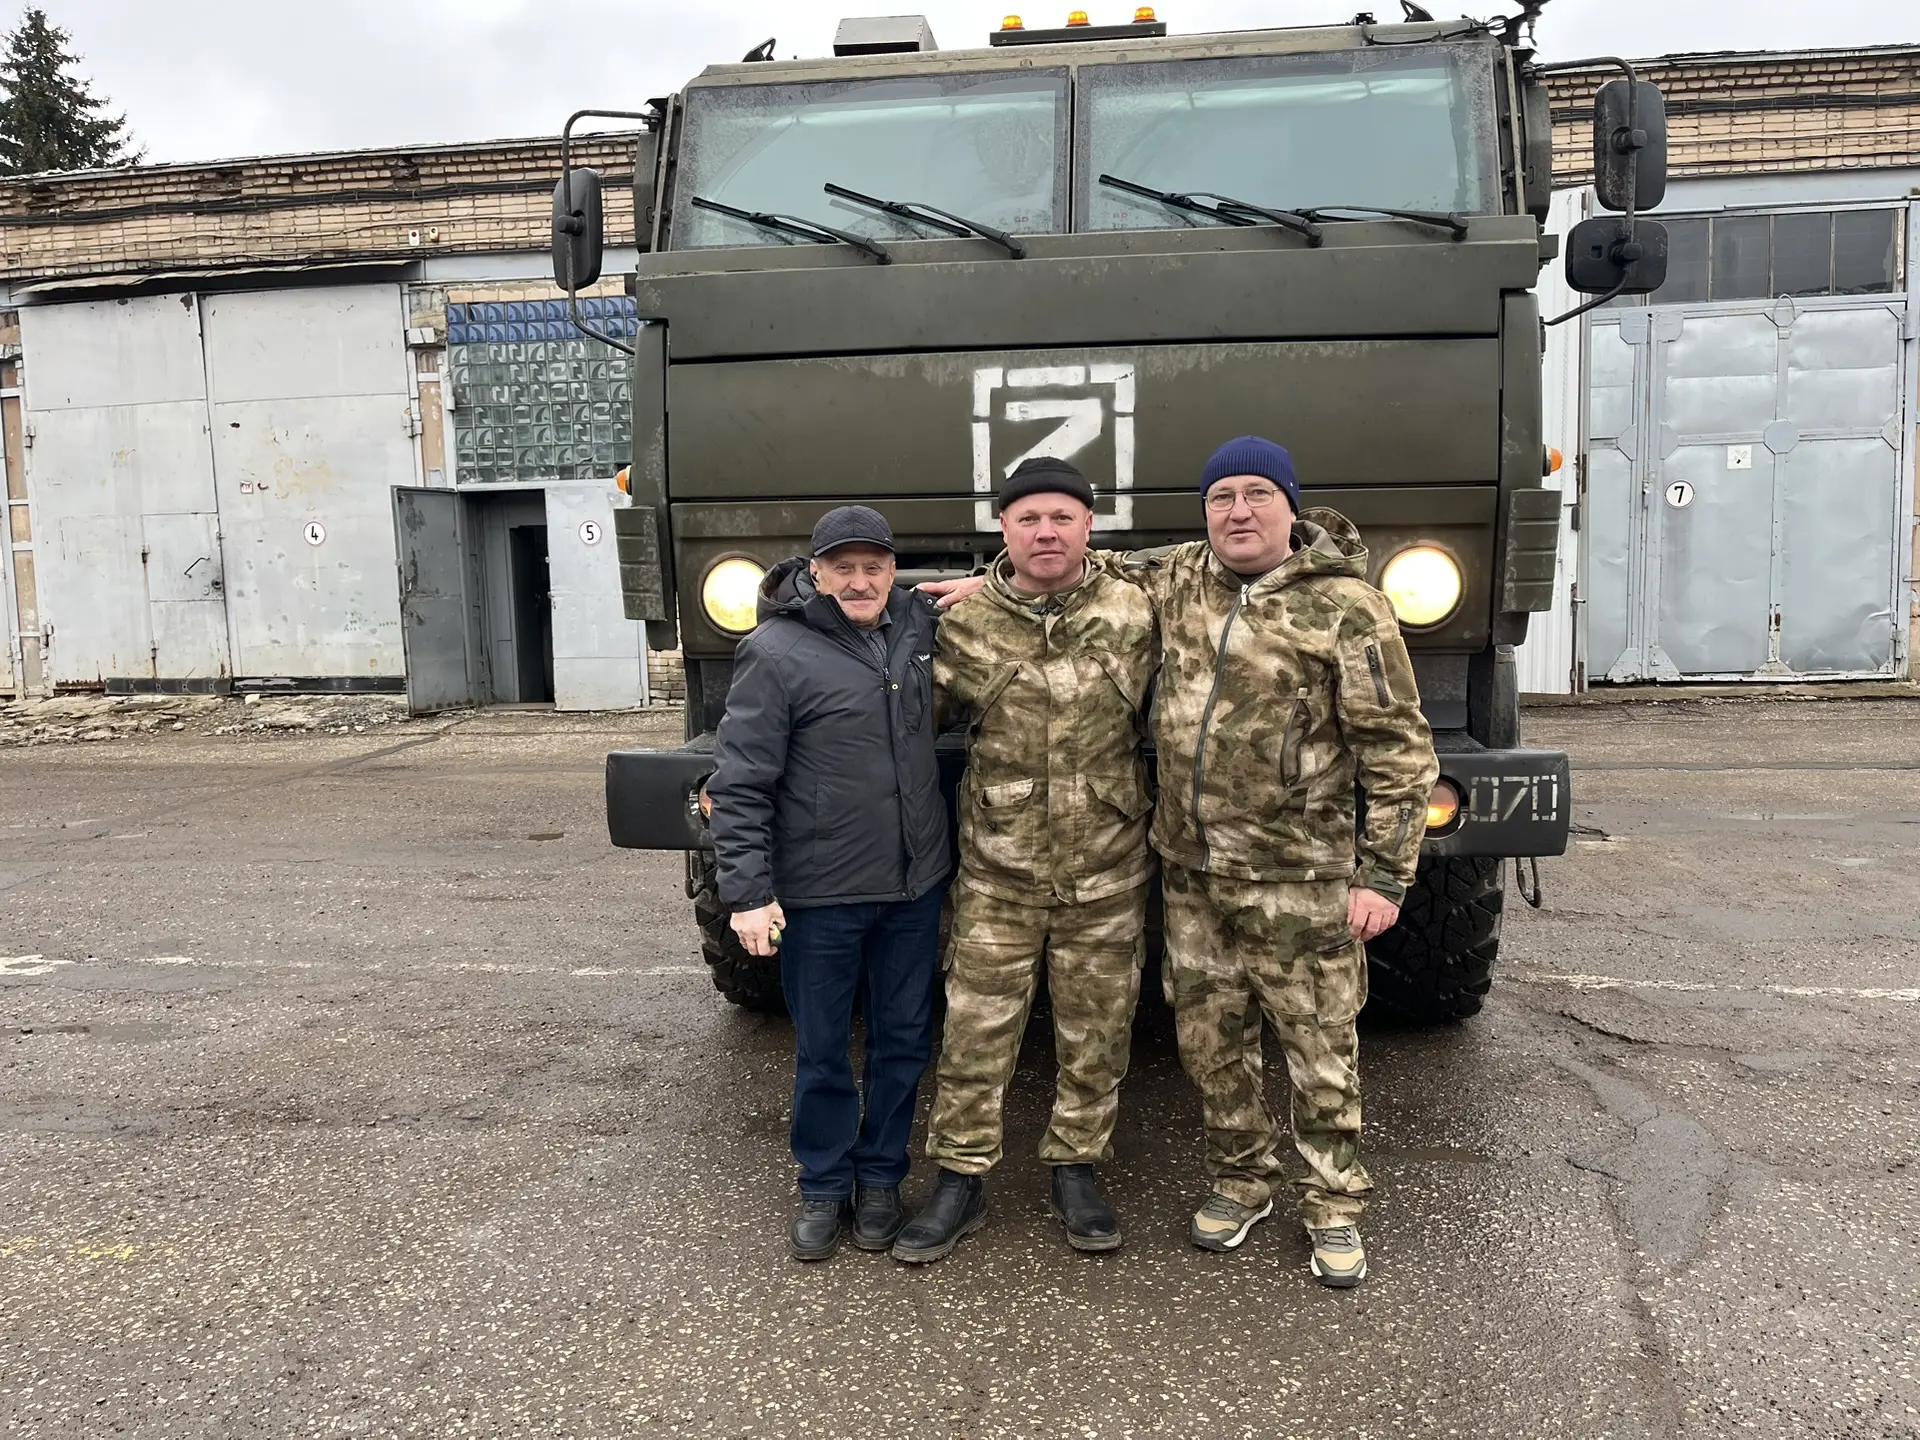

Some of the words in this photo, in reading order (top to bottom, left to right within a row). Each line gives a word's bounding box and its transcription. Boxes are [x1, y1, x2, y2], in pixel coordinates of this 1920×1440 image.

[1003, 398, 1103, 499] Z
[1674, 485, 1685, 504] 7
[311, 525, 319, 541] 4
[586, 524, 595, 541] 5
[1470, 775, 1558, 822] 070
